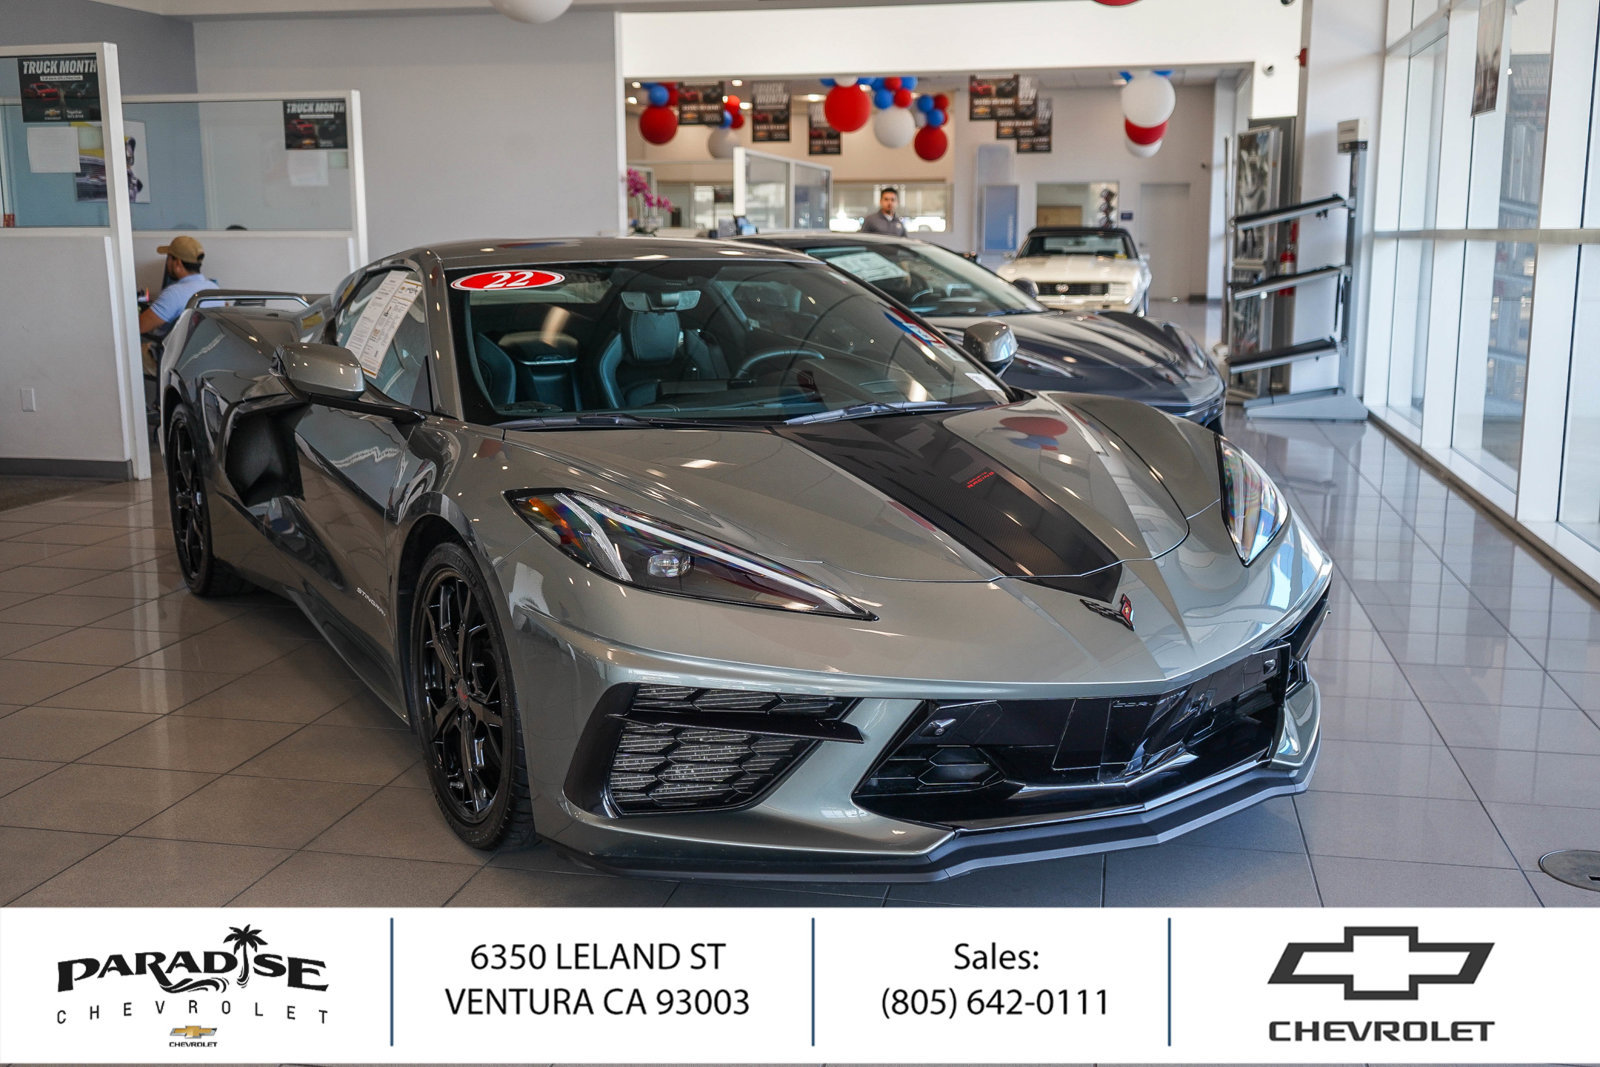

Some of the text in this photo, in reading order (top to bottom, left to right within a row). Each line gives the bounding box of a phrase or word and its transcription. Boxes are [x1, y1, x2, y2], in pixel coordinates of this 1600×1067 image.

[23, 60, 97, 74] TRUCK MONTH
[286, 103, 315, 114] TRUCK
[483, 271, 534, 289] 22
